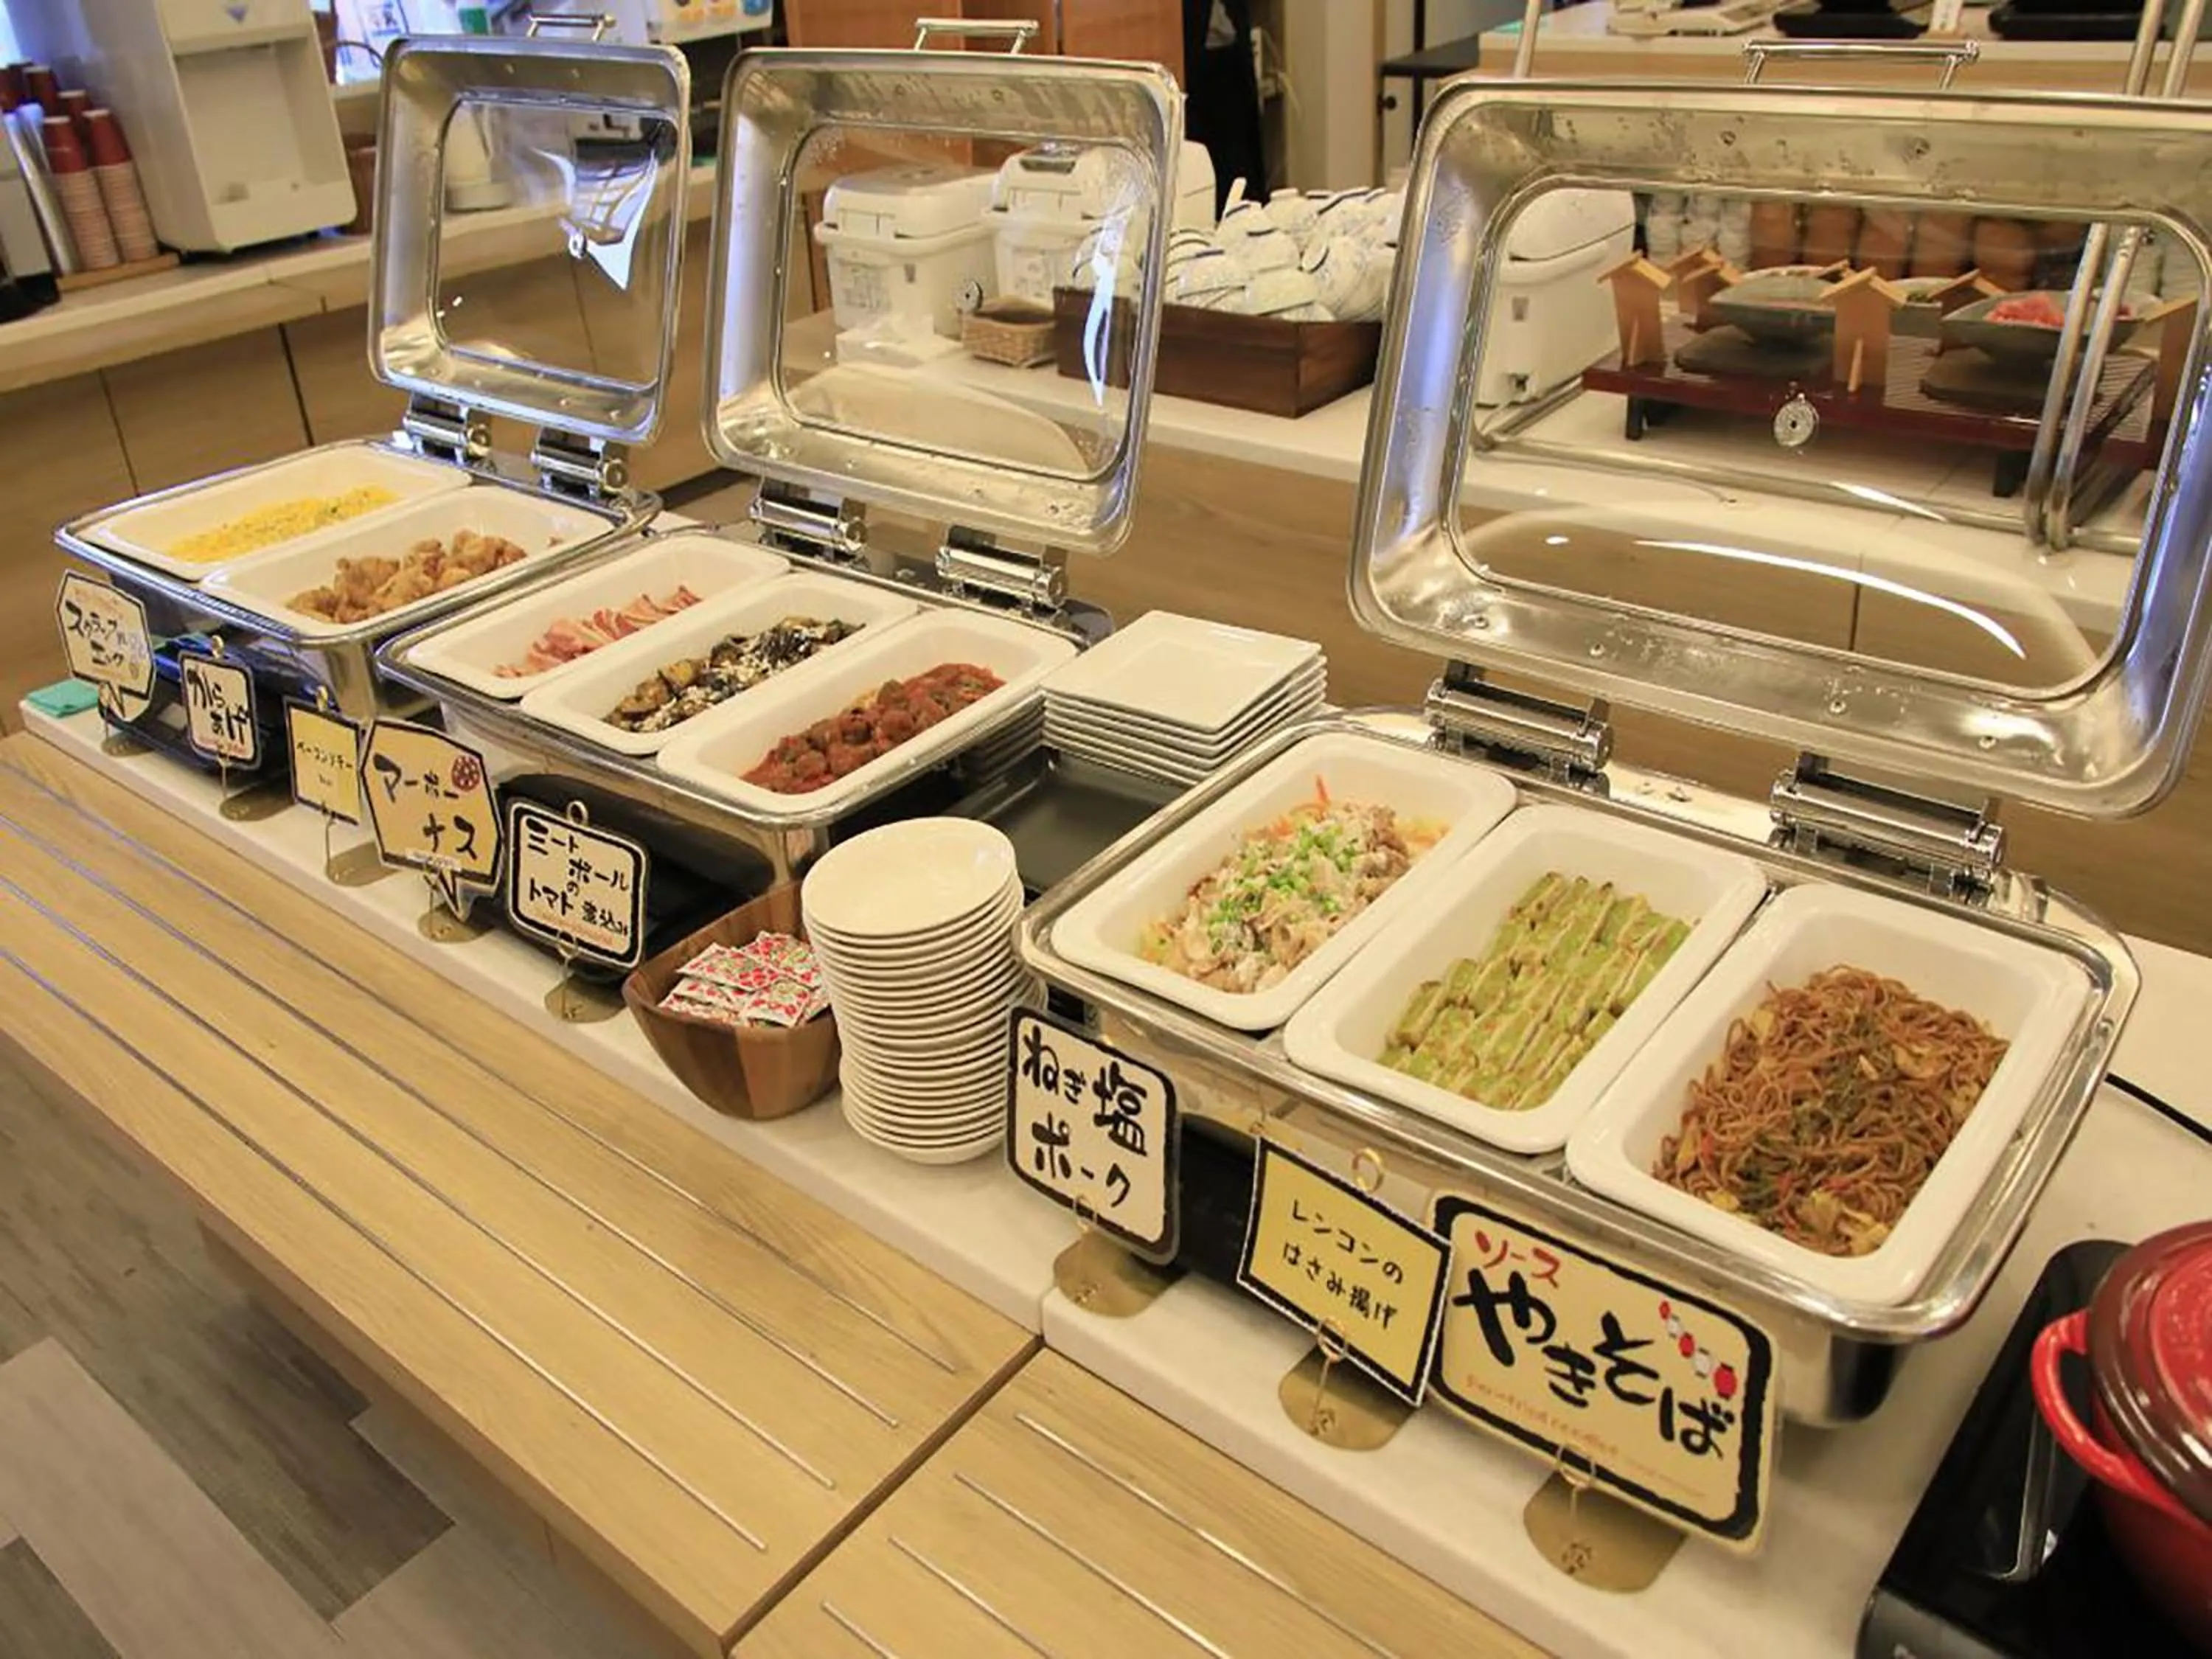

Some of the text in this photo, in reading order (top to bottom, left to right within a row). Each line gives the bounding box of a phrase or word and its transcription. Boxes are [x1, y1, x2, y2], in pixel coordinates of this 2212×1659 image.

[372, 754, 459, 803] マーボー
[422, 813, 477, 860] ナス
[526, 817, 580, 856] ミート
[566, 881, 580, 897] の
[568, 858, 630, 891] ボール
[1023, 1026, 1147, 1157] ねぎ塩
[1032, 1111, 1131, 1208] ポーク
[1292, 1199, 1402, 1284] レンコンの
[1475, 1230, 1559, 1288] ソース
[1282, 1242, 1398, 1329] はさみ揚げ
[1452, 1268, 1735, 1461] やきそば
